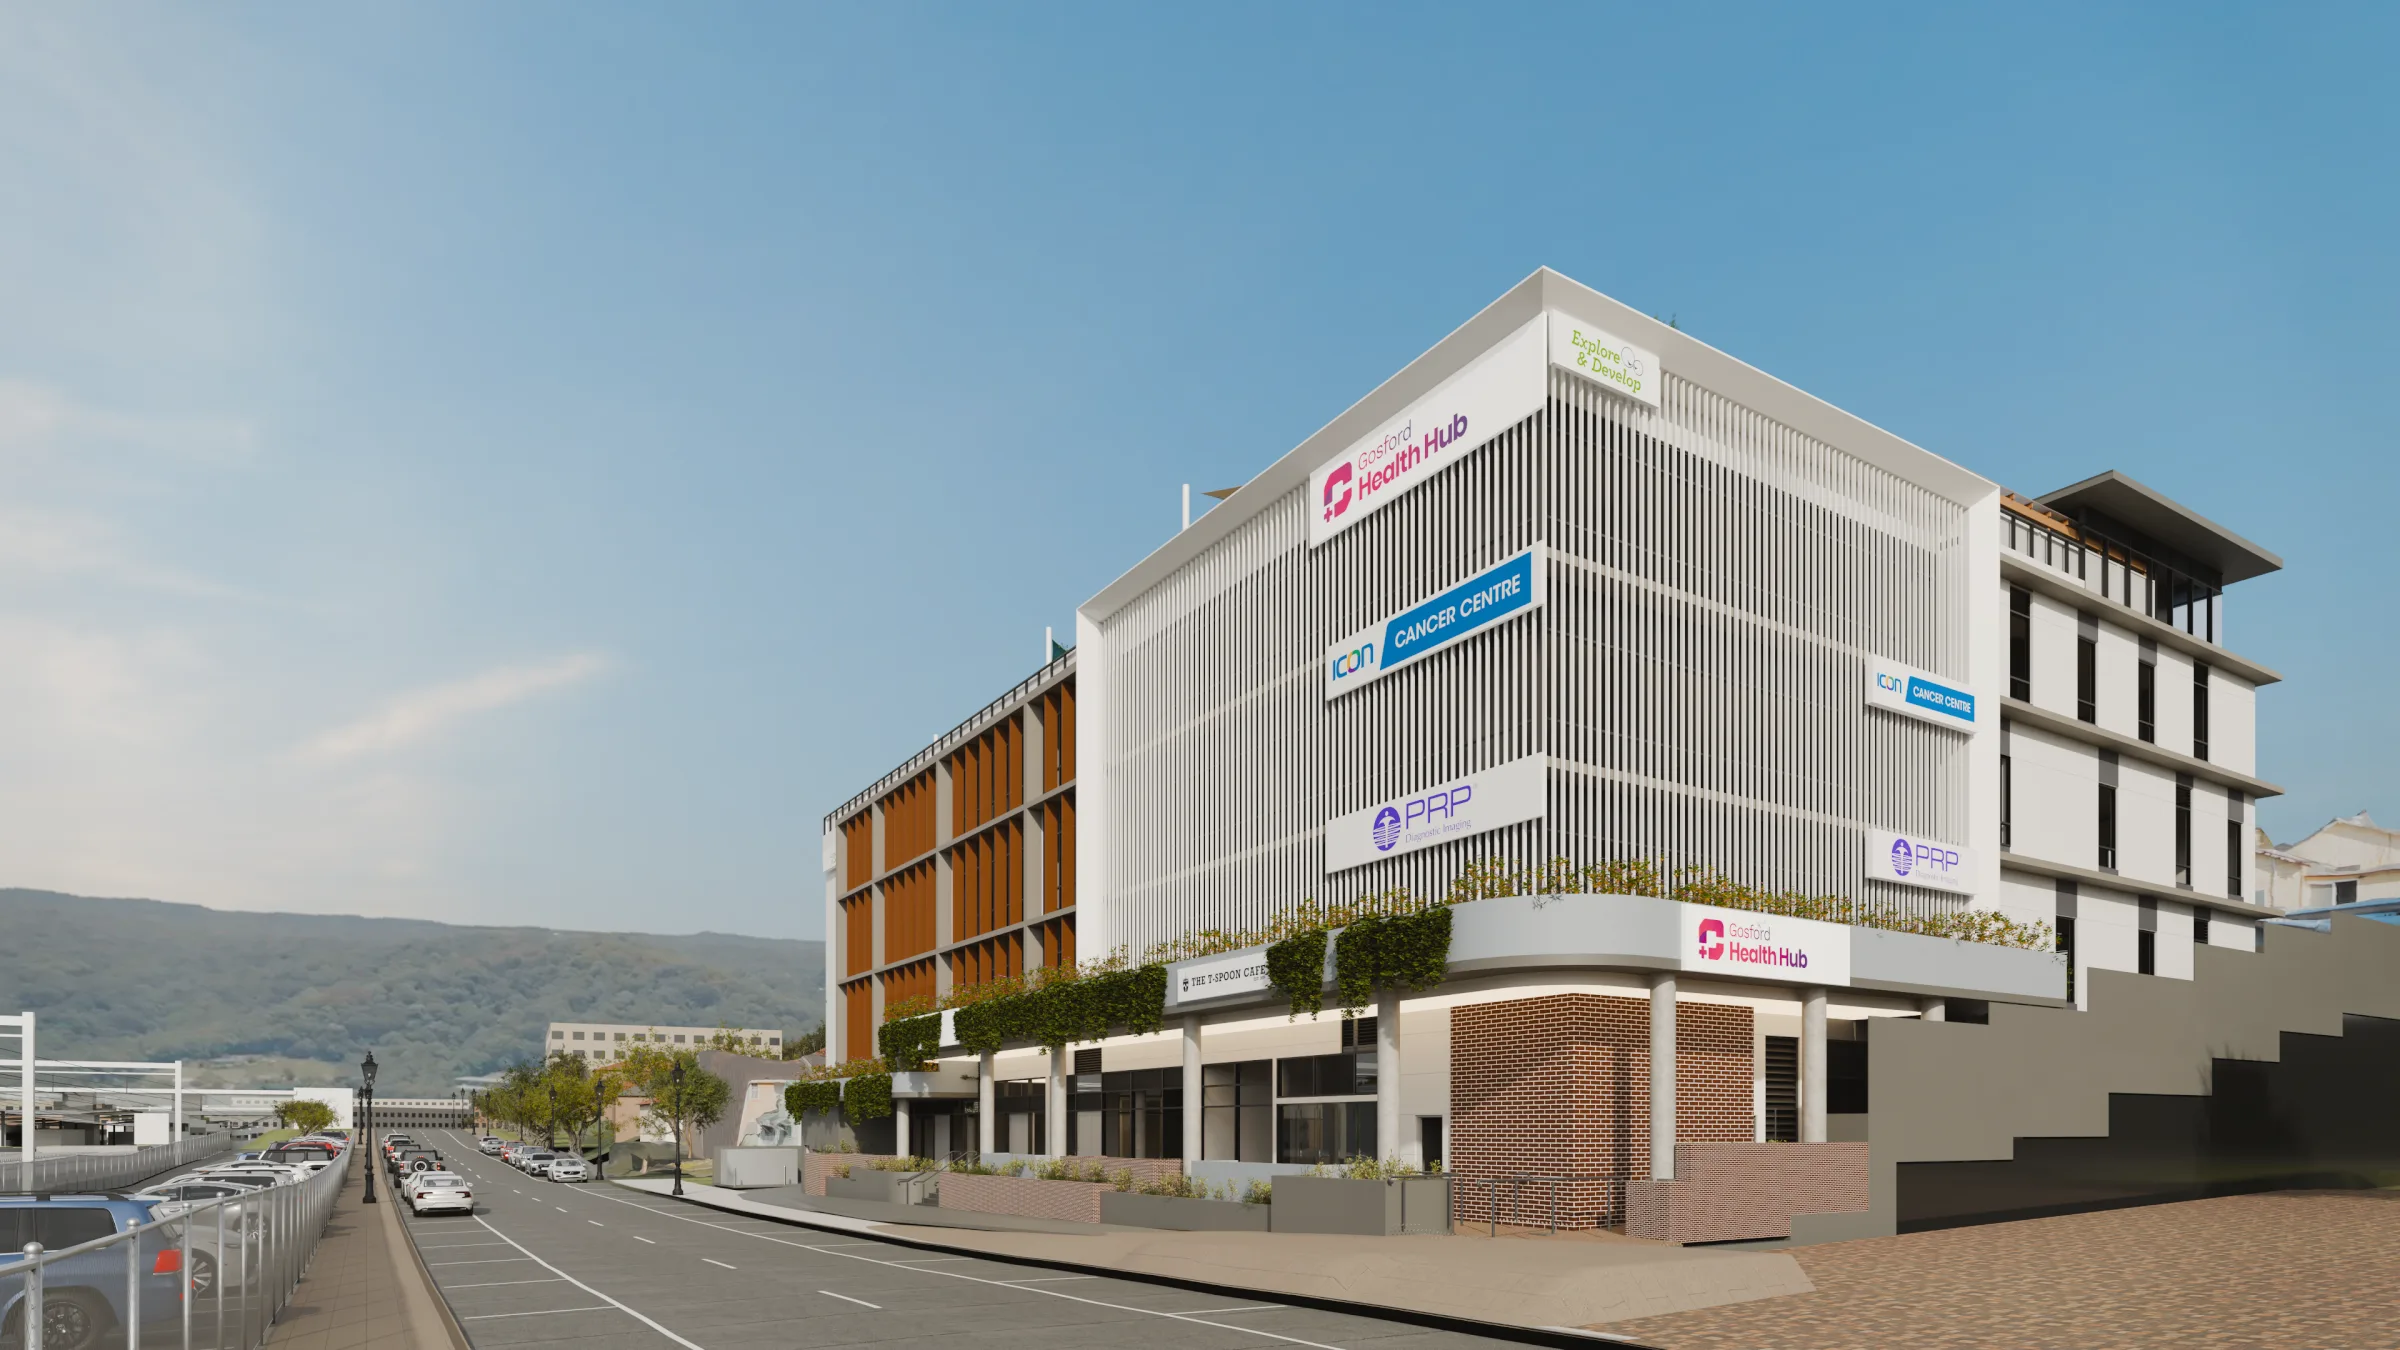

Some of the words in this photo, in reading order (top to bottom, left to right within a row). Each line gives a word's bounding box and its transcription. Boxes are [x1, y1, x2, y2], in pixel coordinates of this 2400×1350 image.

[1571, 329, 1621, 365] Explore
[1577, 351, 1588, 368] &
[1591, 356, 1642, 394] Develop
[1358, 418, 1412, 471] Gosford
[1358, 443, 1421, 501] Health
[1424, 412, 1468, 460] Hub
[1394, 605, 1456, 649] CANCER
[1459, 573, 1521, 618] CENTRE
[1912, 685, 1944, 706] CANCER
[1944, 695, 1971, 714] CENTRE
[1405, 784, 1472, 830] PRP
[1405, 827, 1441, 844] Diagnostic
[1443, 819, 1472, 833] Imaging
[1915, 844, 1959, 872] PRP
[1729, 922, 1771, 941] Gosford
[1729, 941, 1777, 966] Health
[1779, 947, 1808, 969] Hub
[1191, 975, 1206, 987] THE
[1207, 968, 1242, 984] T-SPOON
